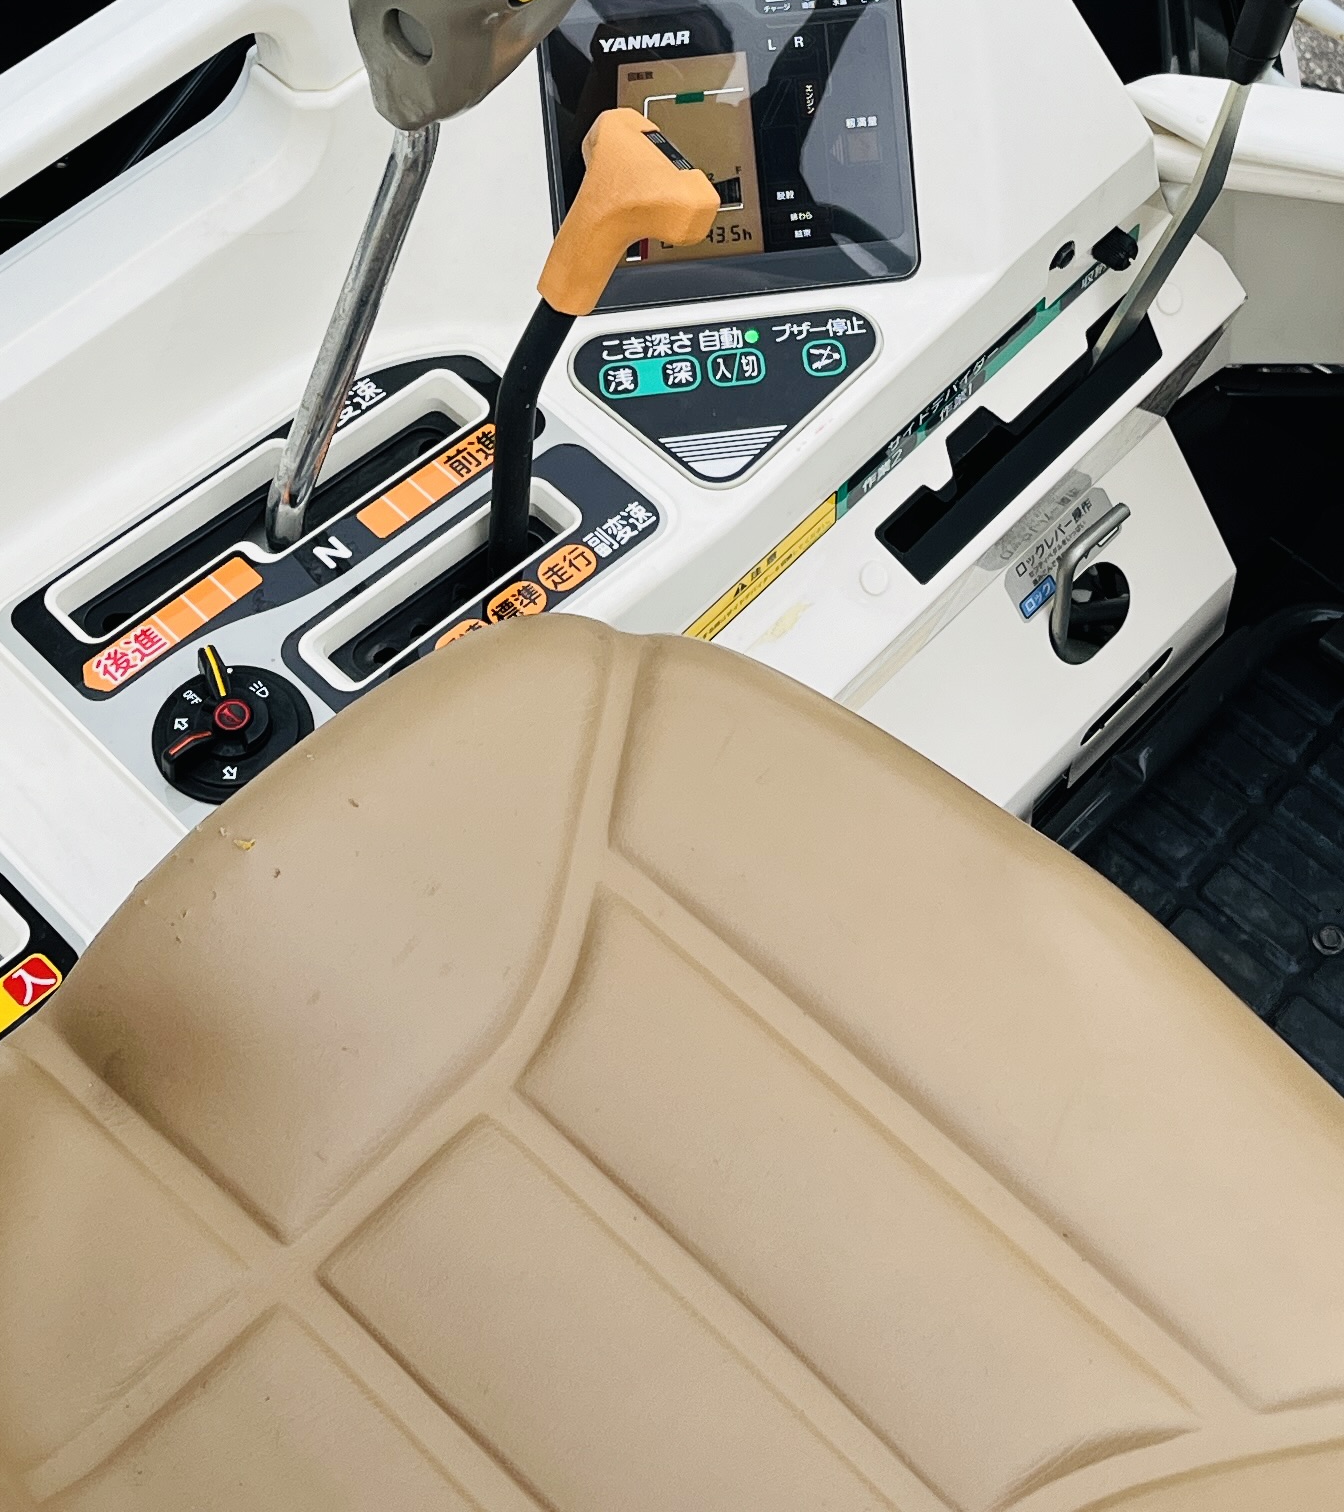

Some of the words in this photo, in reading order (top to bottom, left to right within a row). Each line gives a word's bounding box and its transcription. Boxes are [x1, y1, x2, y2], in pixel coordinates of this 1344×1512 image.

[599, 30, 691, 53] YANMAR
[768, 39, 776, 51] L
[794, 36, 804, 48] R
[771, 316, 867, 343] ブザー停止
[602, 331, 694, 361] こき深さ
[698, 328, 744, 353] 自動
[607, 368, 636, 393] 浅
[665, 361, 695, 386] 深
[583, 501, 657, 558] 副変速
[312, 535, 353, 570] N
[541, 548, 594, 590] 走行
[1025, 583, 1051, 612] ロック
[94, 622, 172, 684] 後進
[183, 689, 202, 704] OFF
[11, 969, 57, 1005] 入
